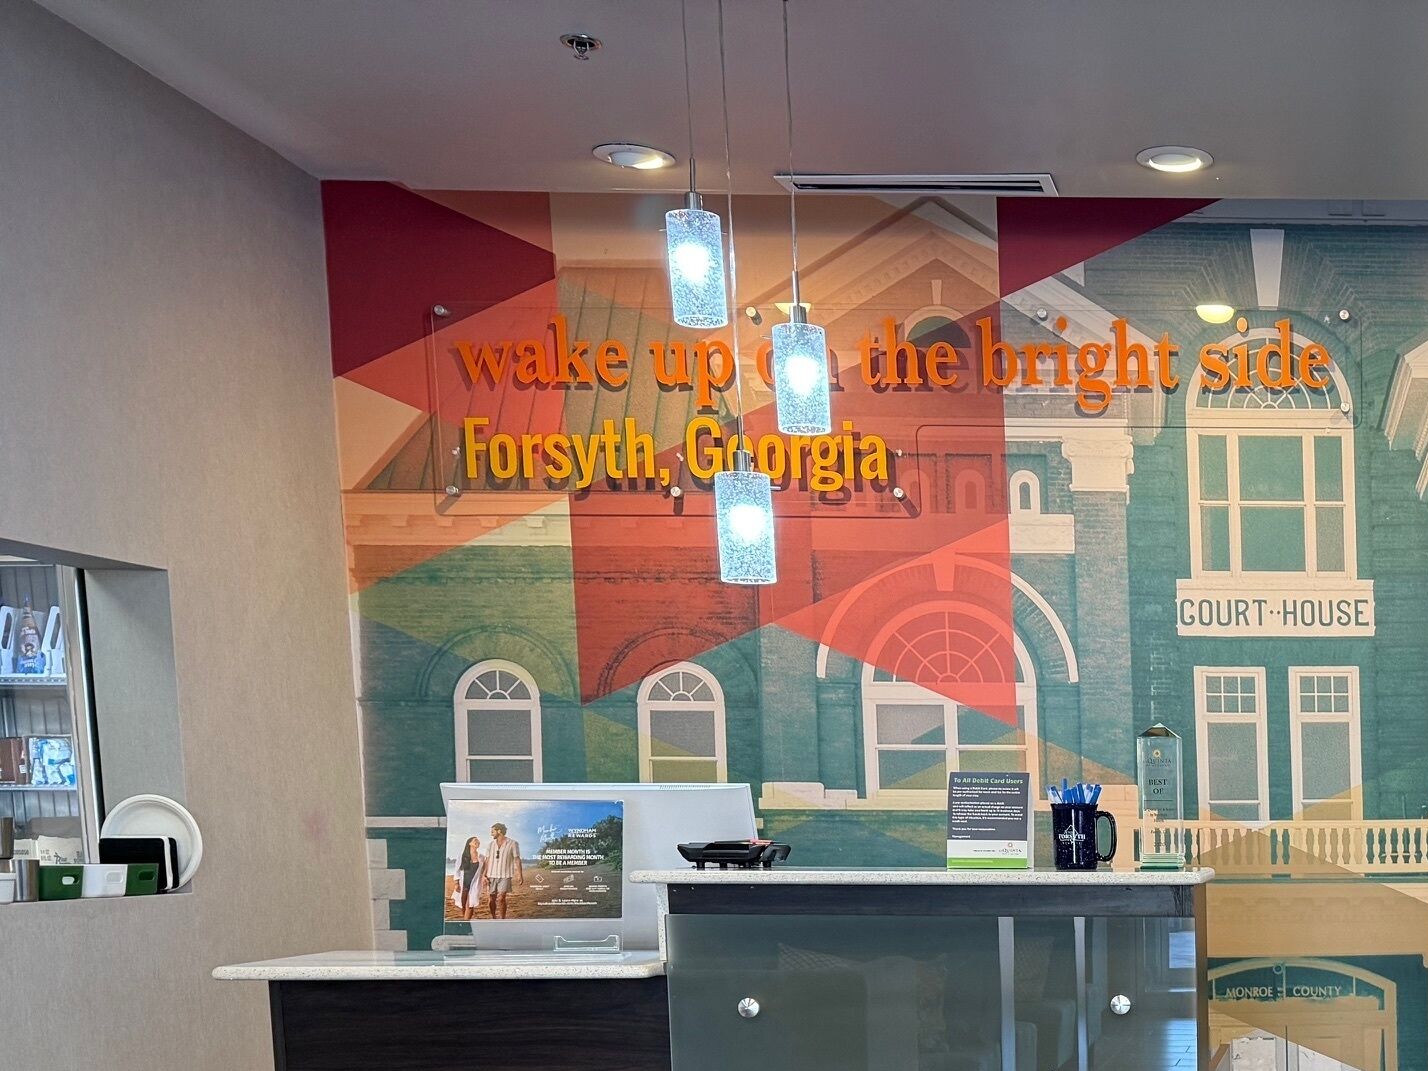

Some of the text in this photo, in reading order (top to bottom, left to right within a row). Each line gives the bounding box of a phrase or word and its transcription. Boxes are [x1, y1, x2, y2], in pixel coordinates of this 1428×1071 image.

[457, 315, 629, 386] wake
[649, 339, 734, 407] up
[860, 316, 959, 386] the
[976, 316, 1179, 412] bright
[1200, 316, 1330, 389] side
[464, 417, 671, 489] Forsyth,
[1149, 779, 1168, 787] BEST
[1225, 985, 1341, 998] MONROE COUNTY
